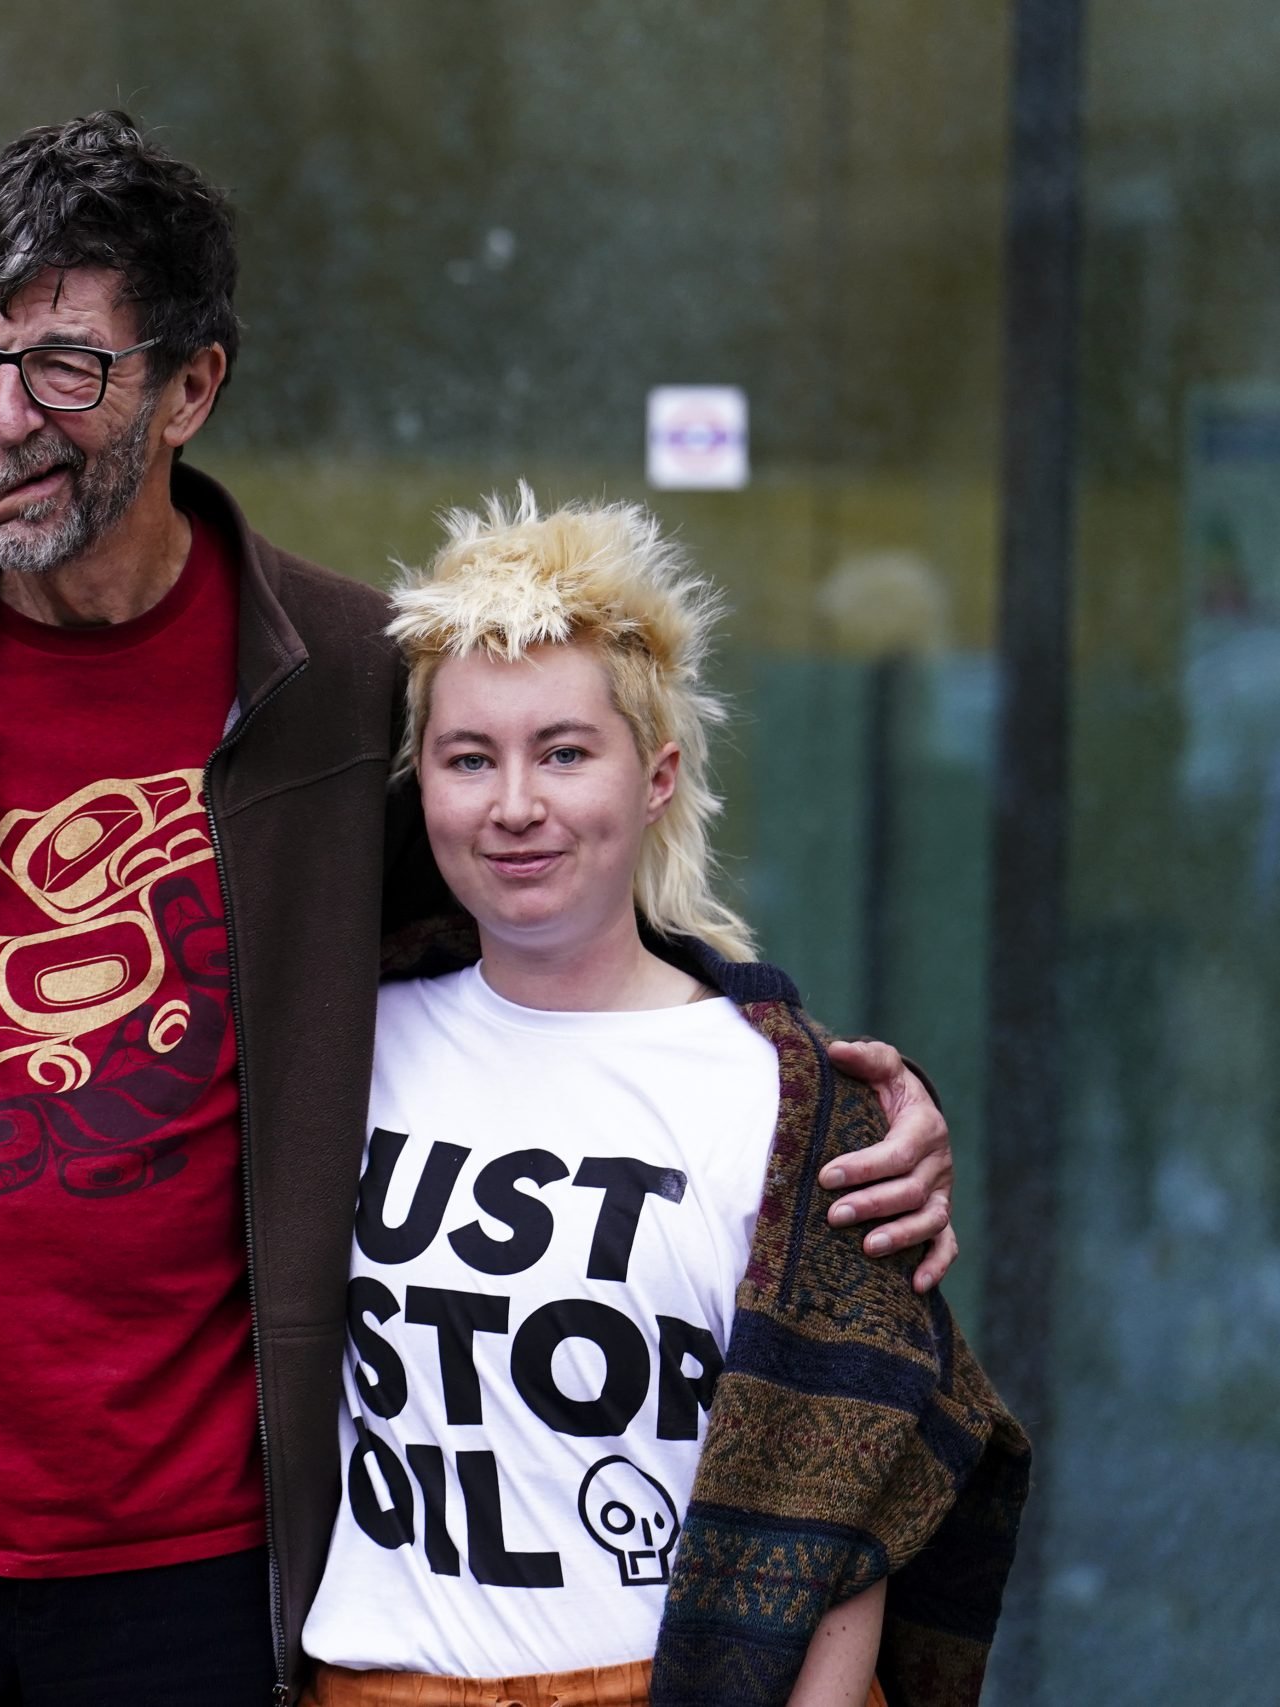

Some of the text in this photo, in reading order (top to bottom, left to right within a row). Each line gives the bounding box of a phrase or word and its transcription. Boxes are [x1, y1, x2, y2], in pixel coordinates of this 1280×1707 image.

[355, 1127, 688, 1283] UST
[347, 1276, 725, 1440] STOP
[348, 1416, 564, 1588] OIL
